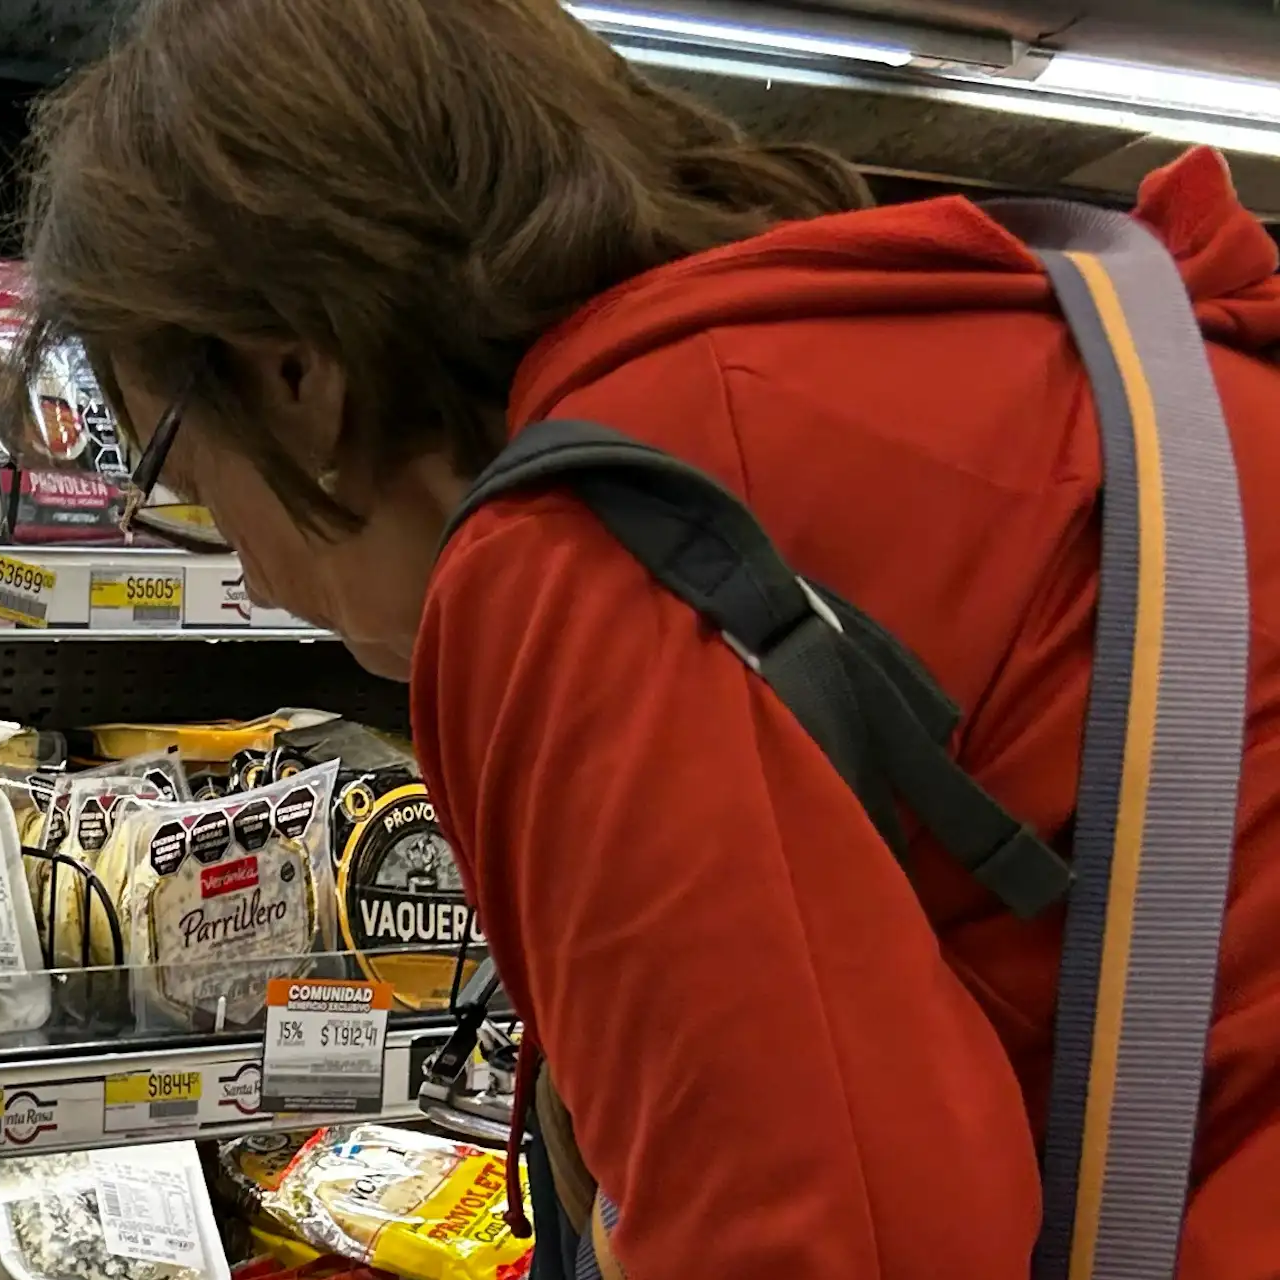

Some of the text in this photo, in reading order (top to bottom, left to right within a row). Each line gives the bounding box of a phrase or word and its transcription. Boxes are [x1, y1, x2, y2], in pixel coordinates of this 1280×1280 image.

[179, 889, 286, 948] Parrillero
[288, 984, 373, 1003] COMUNIDAD
[280, 1021, 303, 1039] 15%
